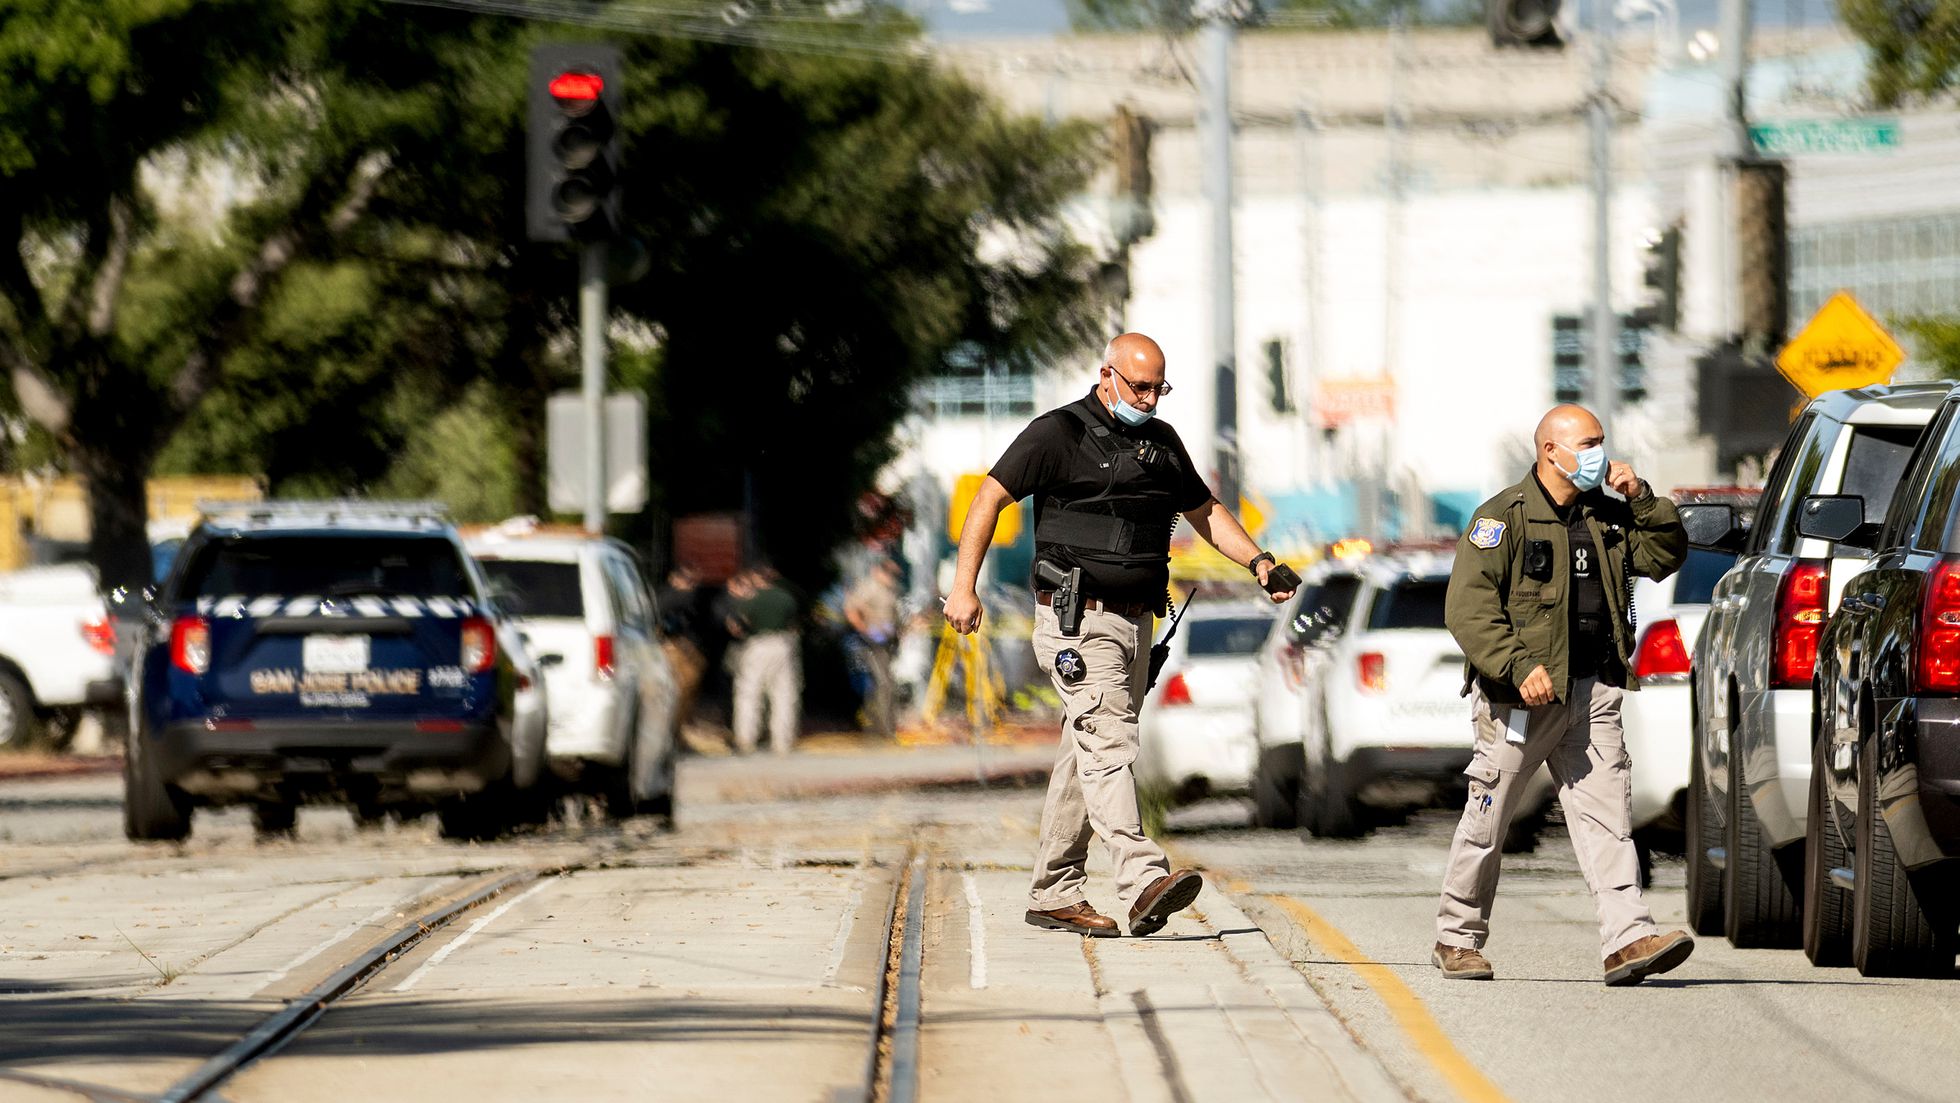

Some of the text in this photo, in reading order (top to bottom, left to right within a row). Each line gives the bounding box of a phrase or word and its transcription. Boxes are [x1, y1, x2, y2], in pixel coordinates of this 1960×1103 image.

[1575, 548, 1588, 572] 8
[250, 669, 295, 694] SAN
[352, 669, 421, 694] POLICE
